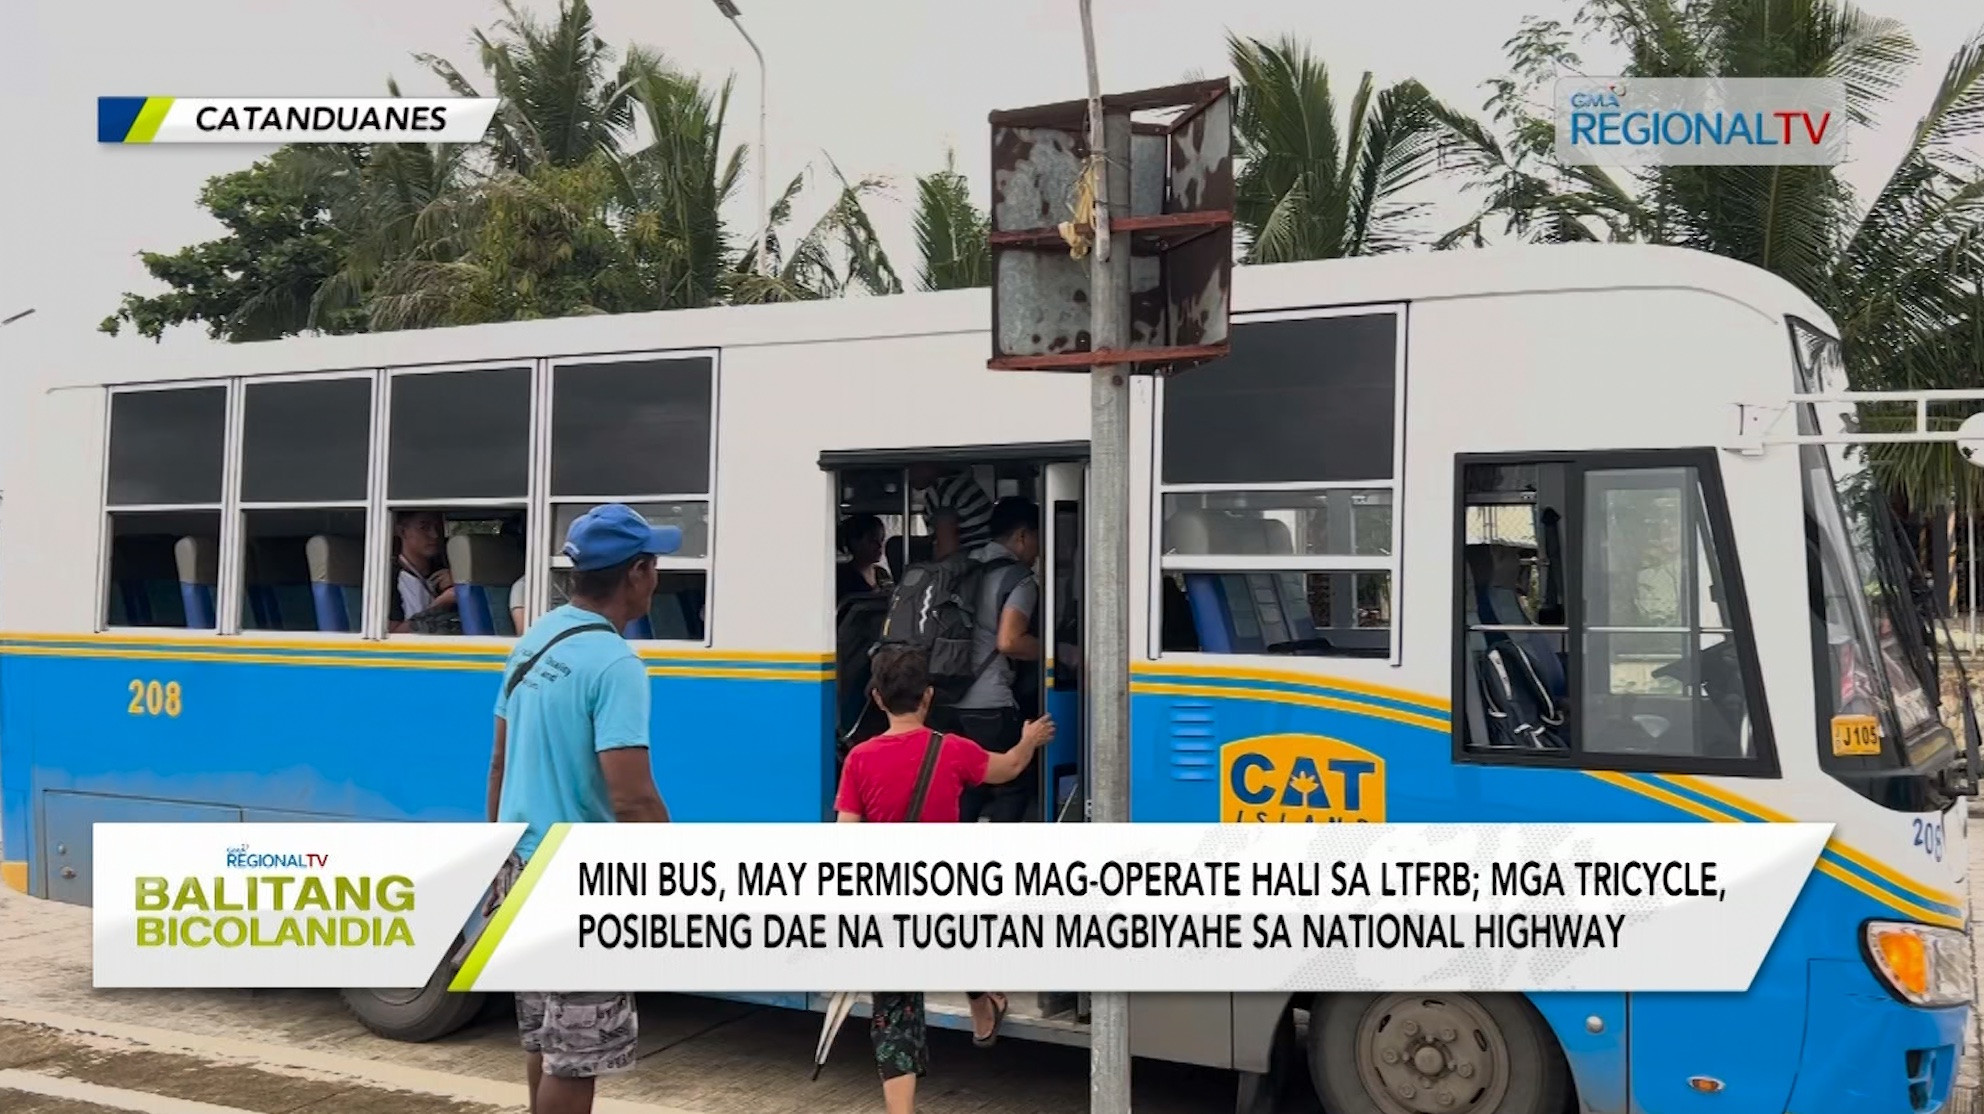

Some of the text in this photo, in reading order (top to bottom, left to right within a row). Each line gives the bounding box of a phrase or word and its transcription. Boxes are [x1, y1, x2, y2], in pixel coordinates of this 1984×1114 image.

[127, 679, 182, 717] 208
[1843, 726, 1878, 746] J105
[1231, 752, 1375, 811] CAT
